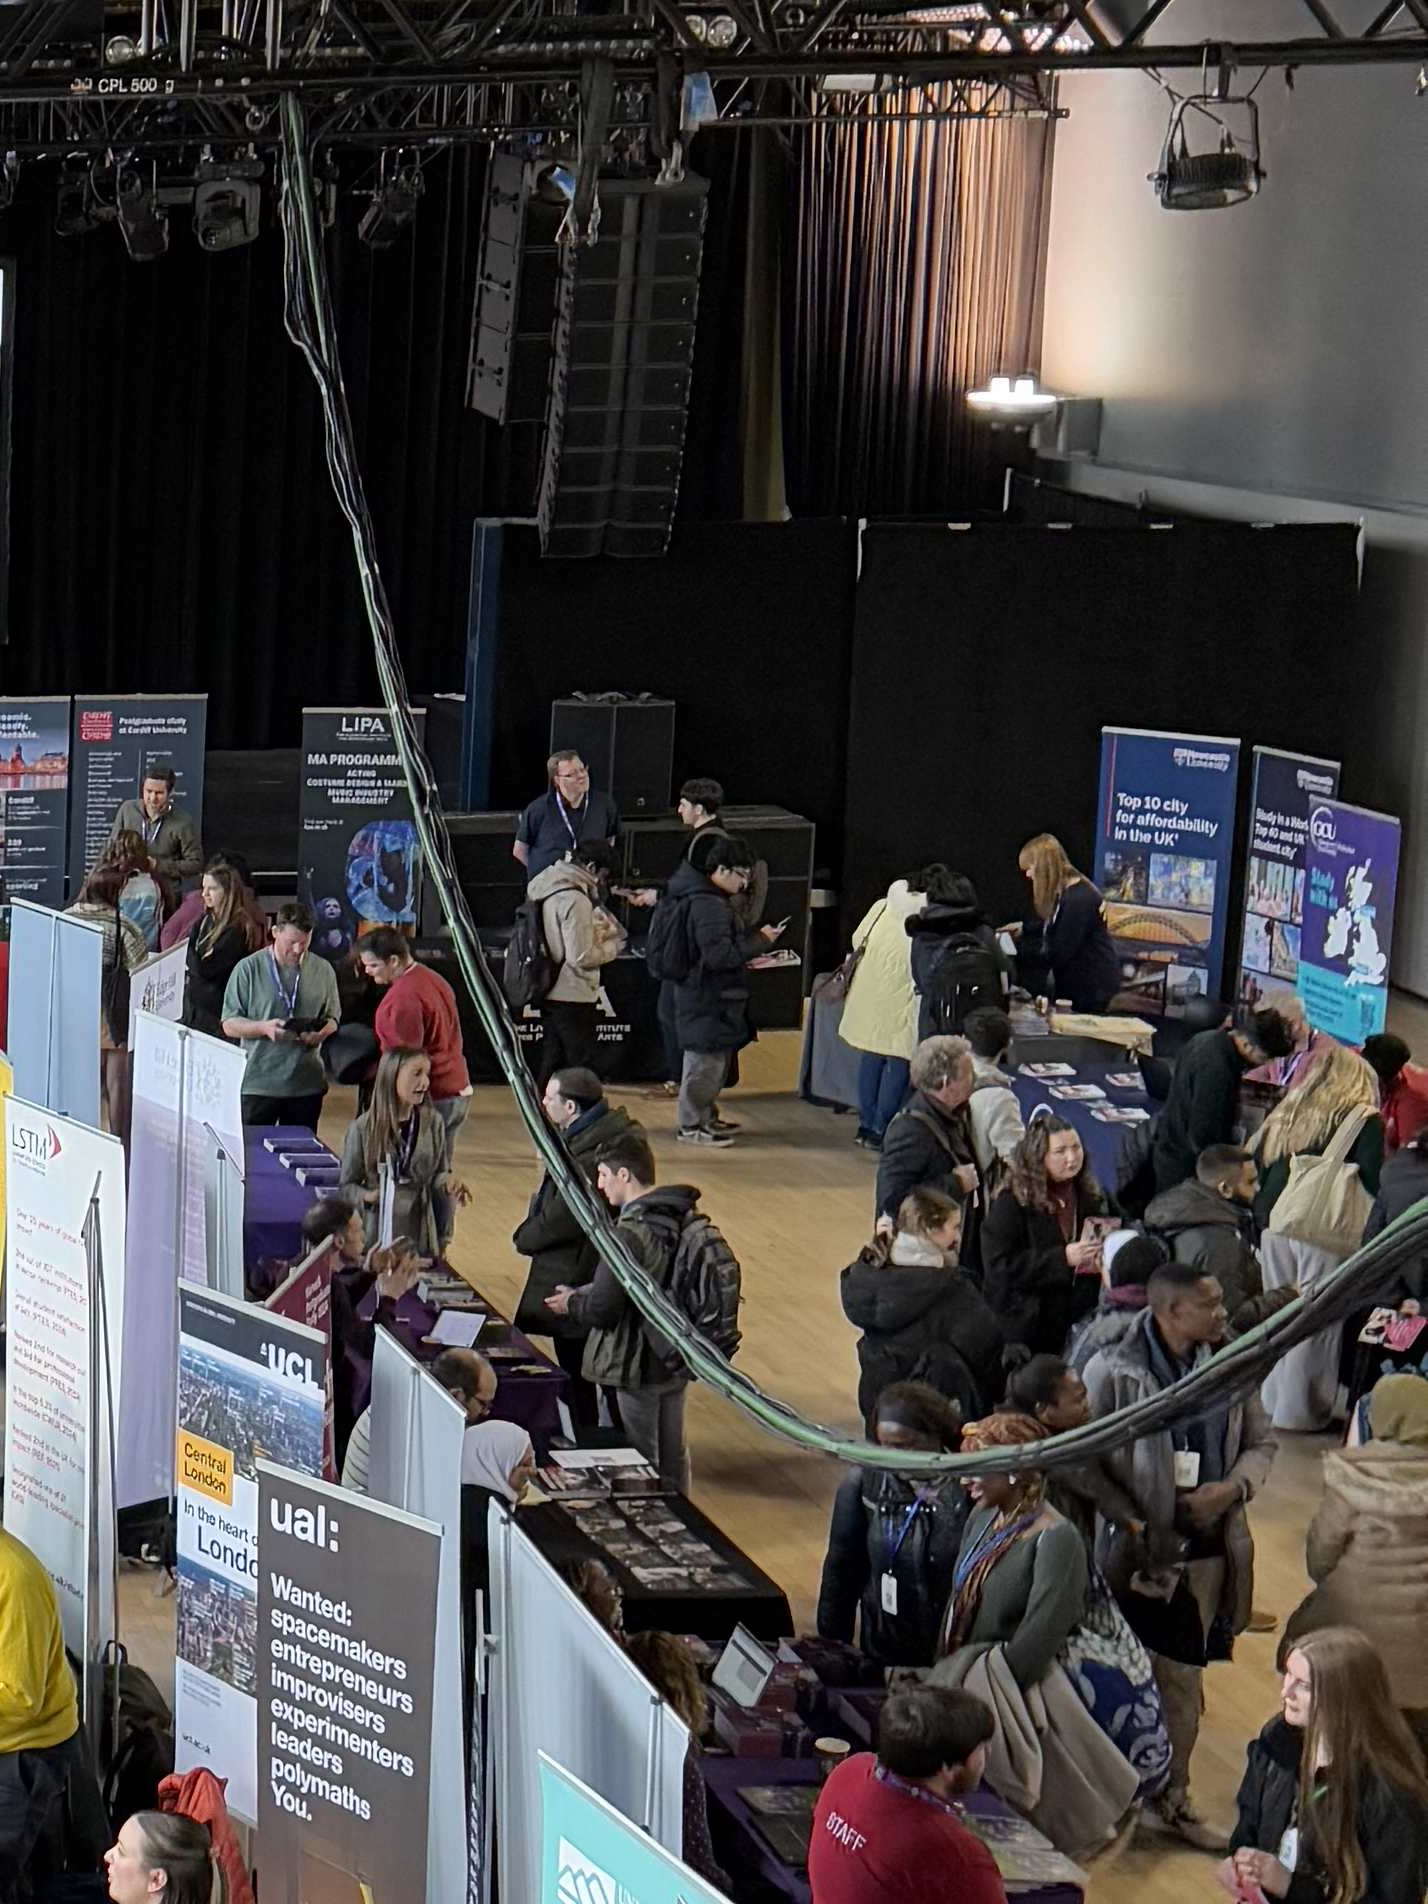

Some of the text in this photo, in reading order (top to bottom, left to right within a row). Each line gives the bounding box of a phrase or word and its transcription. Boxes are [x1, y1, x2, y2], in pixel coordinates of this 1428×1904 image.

[341, 717, 385, 732] LIPA
[307, 753, 328, 765] MA
[1116, 809, 1218, 837] for affordability
[1117, 793, 1189, 816] Top 10 city
[1114, 826, 1151, 843] in the
[268, 1343, 318, 1385] UCL
[184, 1442, 226, 1474] Central
[184, 1460, 226, 1495] London
[184, 1498, 249, 1544] In the heart
[271, 1497, 339, 1553] ual:
[271, 1572, 352, 1627] Wanted:
[271, 1608, 407, 1681] spacemakers
[271, 1638, 414, 1715] entrepreneurs
[271, 1662, 386, 1735] improvisers
[271, 1697, 414, 1778] experimenters
[271, 1721, 344, 1776] leaders
[271, 1756, 371, 1821] polymaths
[271, 1780, 313, 1821] You.
[826, 1811, 867, 1851] STAFF
